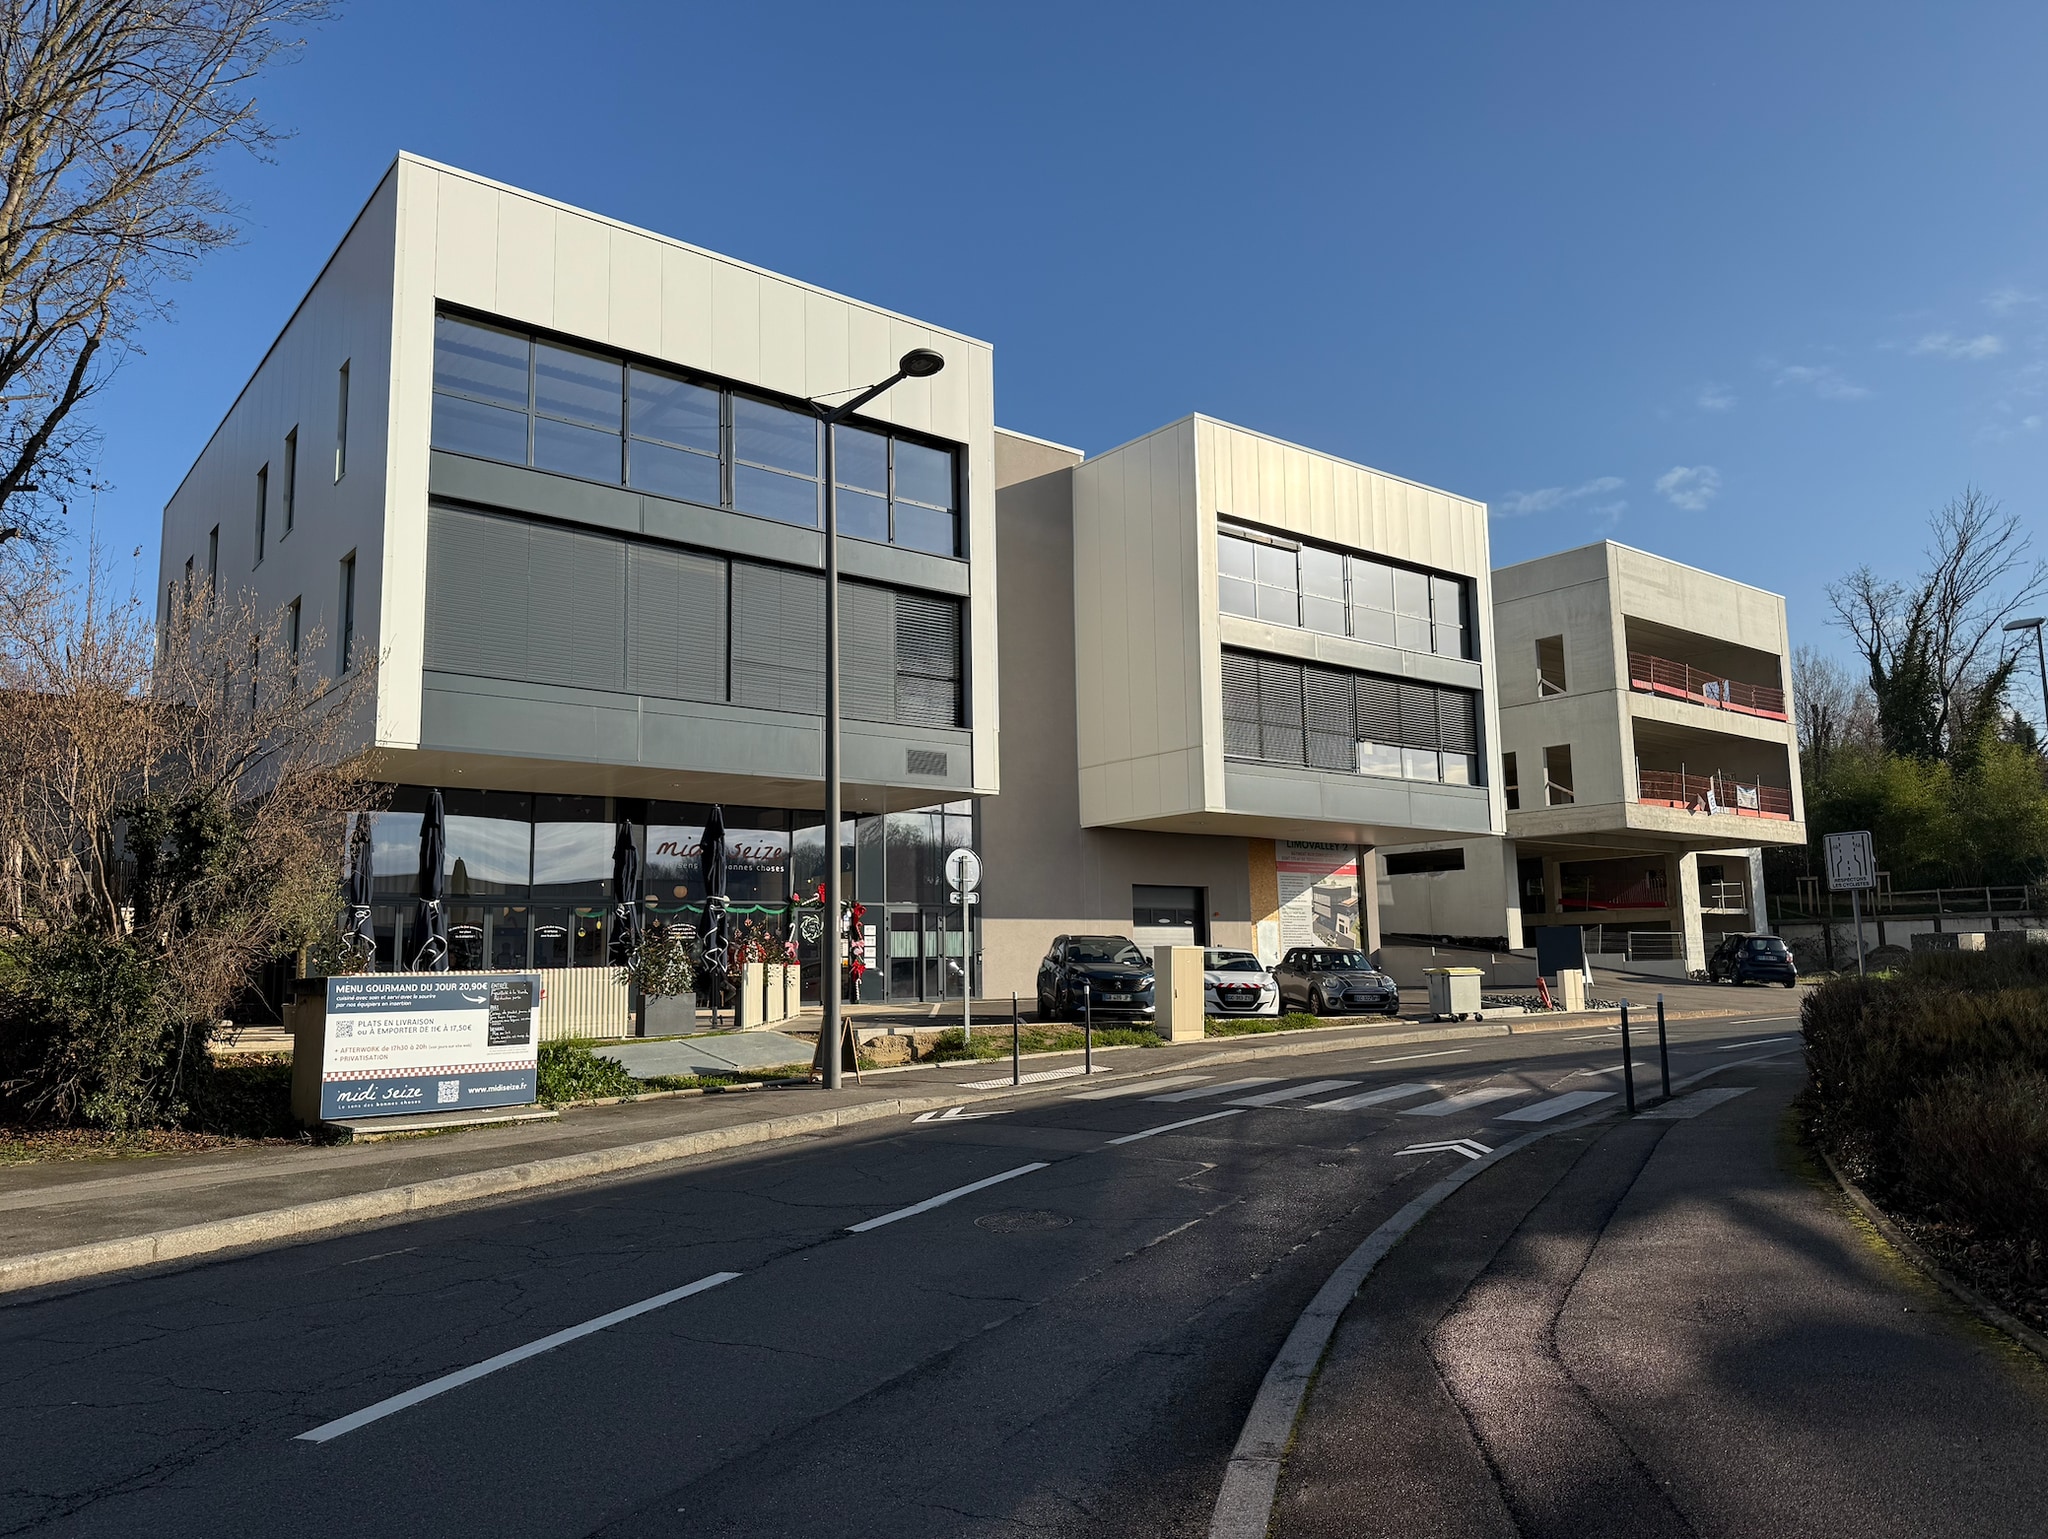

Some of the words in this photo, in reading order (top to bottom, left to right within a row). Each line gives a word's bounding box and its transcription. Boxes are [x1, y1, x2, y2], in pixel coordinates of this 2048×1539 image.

[728, 839, 784, 860] seize
[1287, 840, 1340, 850] LIMOVALLEY
[1342, 843, 1348, 851] 2
[756, 864, 785, 872] choses
[336, 984, 363, 993] MENU
[365, 983, 418, 993] GOURMAND
[420, 983, 433, 992] DU
[434, 983, 457, 991] JOUR
[459, 982, 488, 991] 20,90€
[396, 1018, 435, 1026] LIVRAISON
[369, 1026, 376, 1035] À
[377, 1026, 418, 1034] EMPORTER
[443, 1024, 449, 1032] À
[450, 1024, 472, 1032] 17,50€
[340, 1054, 388, 1062] PRIVATISATION
[336, 1083, 378, 1102] midi
[382, 1084, 423, 1099] seize
[468, 1082, 527, 1094] www.midiseize.fr
